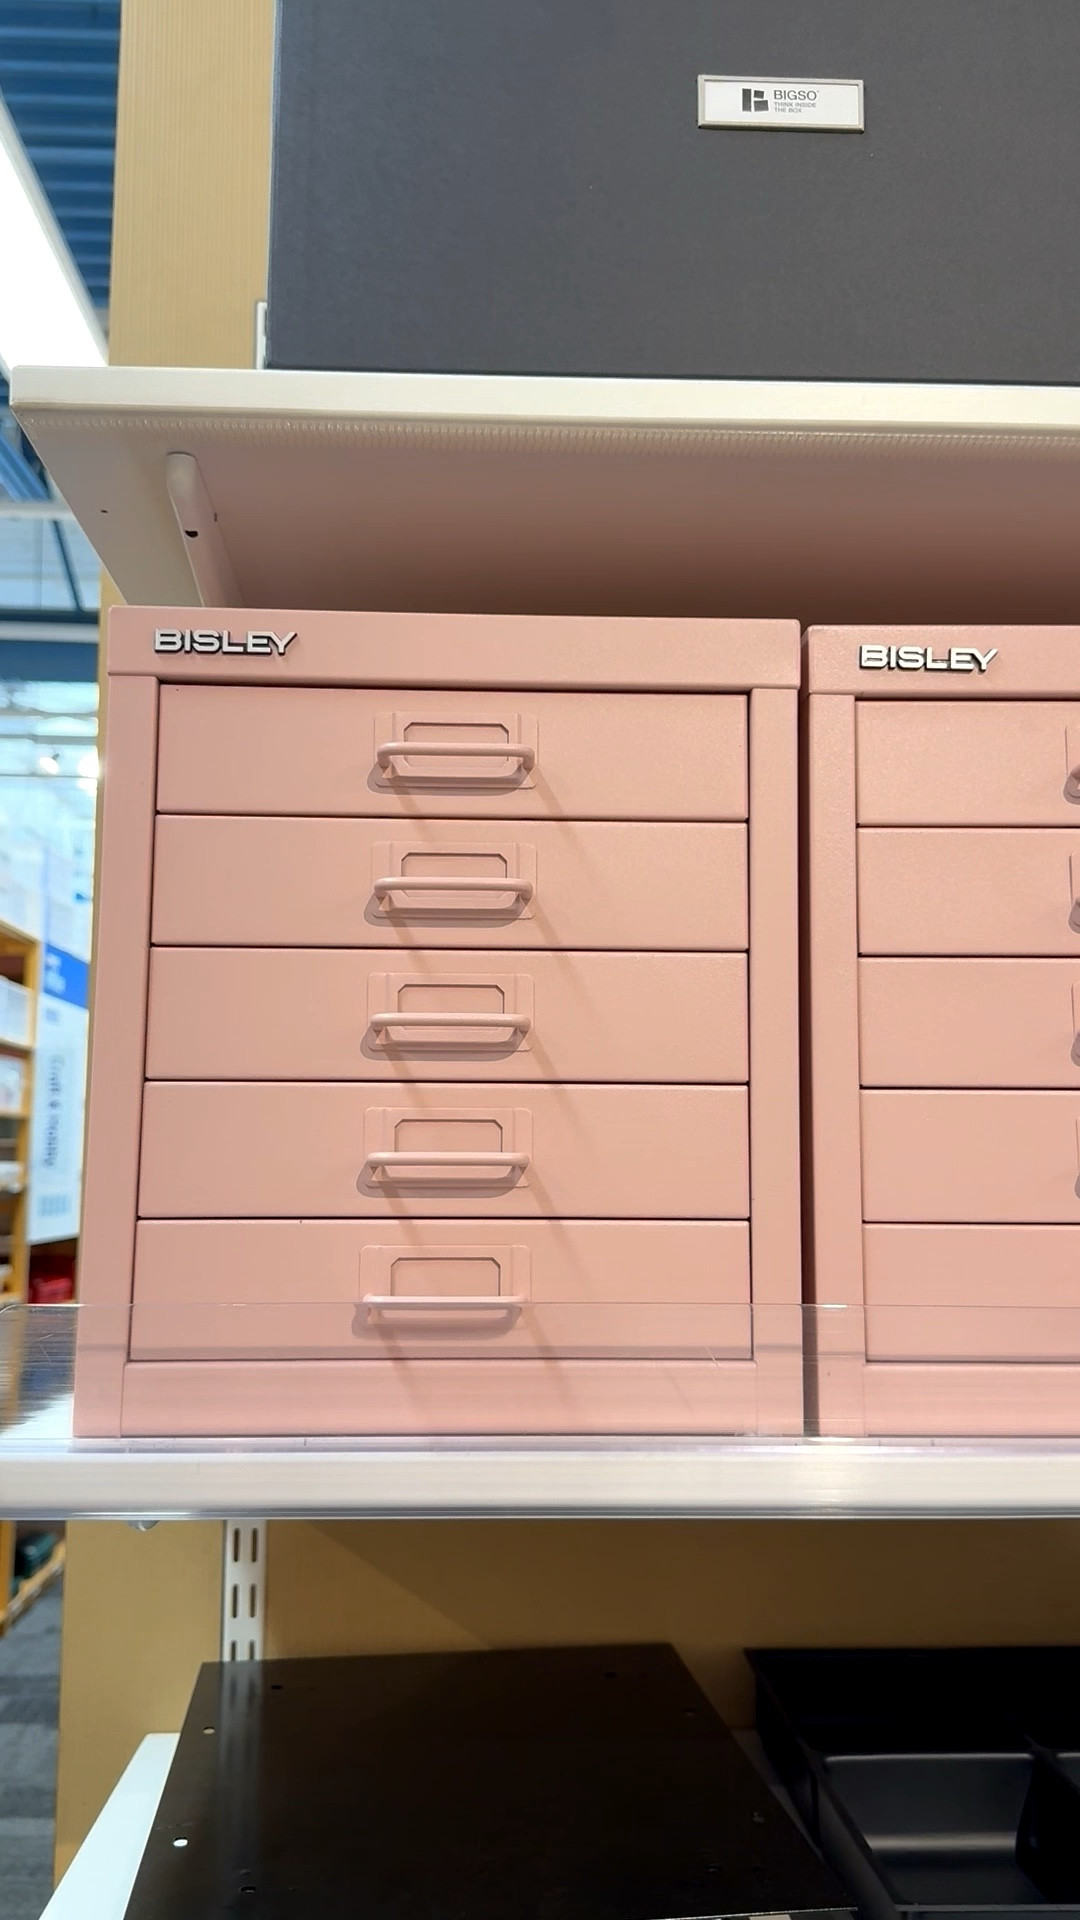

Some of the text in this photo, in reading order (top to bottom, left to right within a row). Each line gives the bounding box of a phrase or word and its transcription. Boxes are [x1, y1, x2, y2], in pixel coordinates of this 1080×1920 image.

[773, 89, 818, 101] BIGSO
[154, 628, 298, 655] BISLEY
[859, 644, 999, 672] BISLEY
